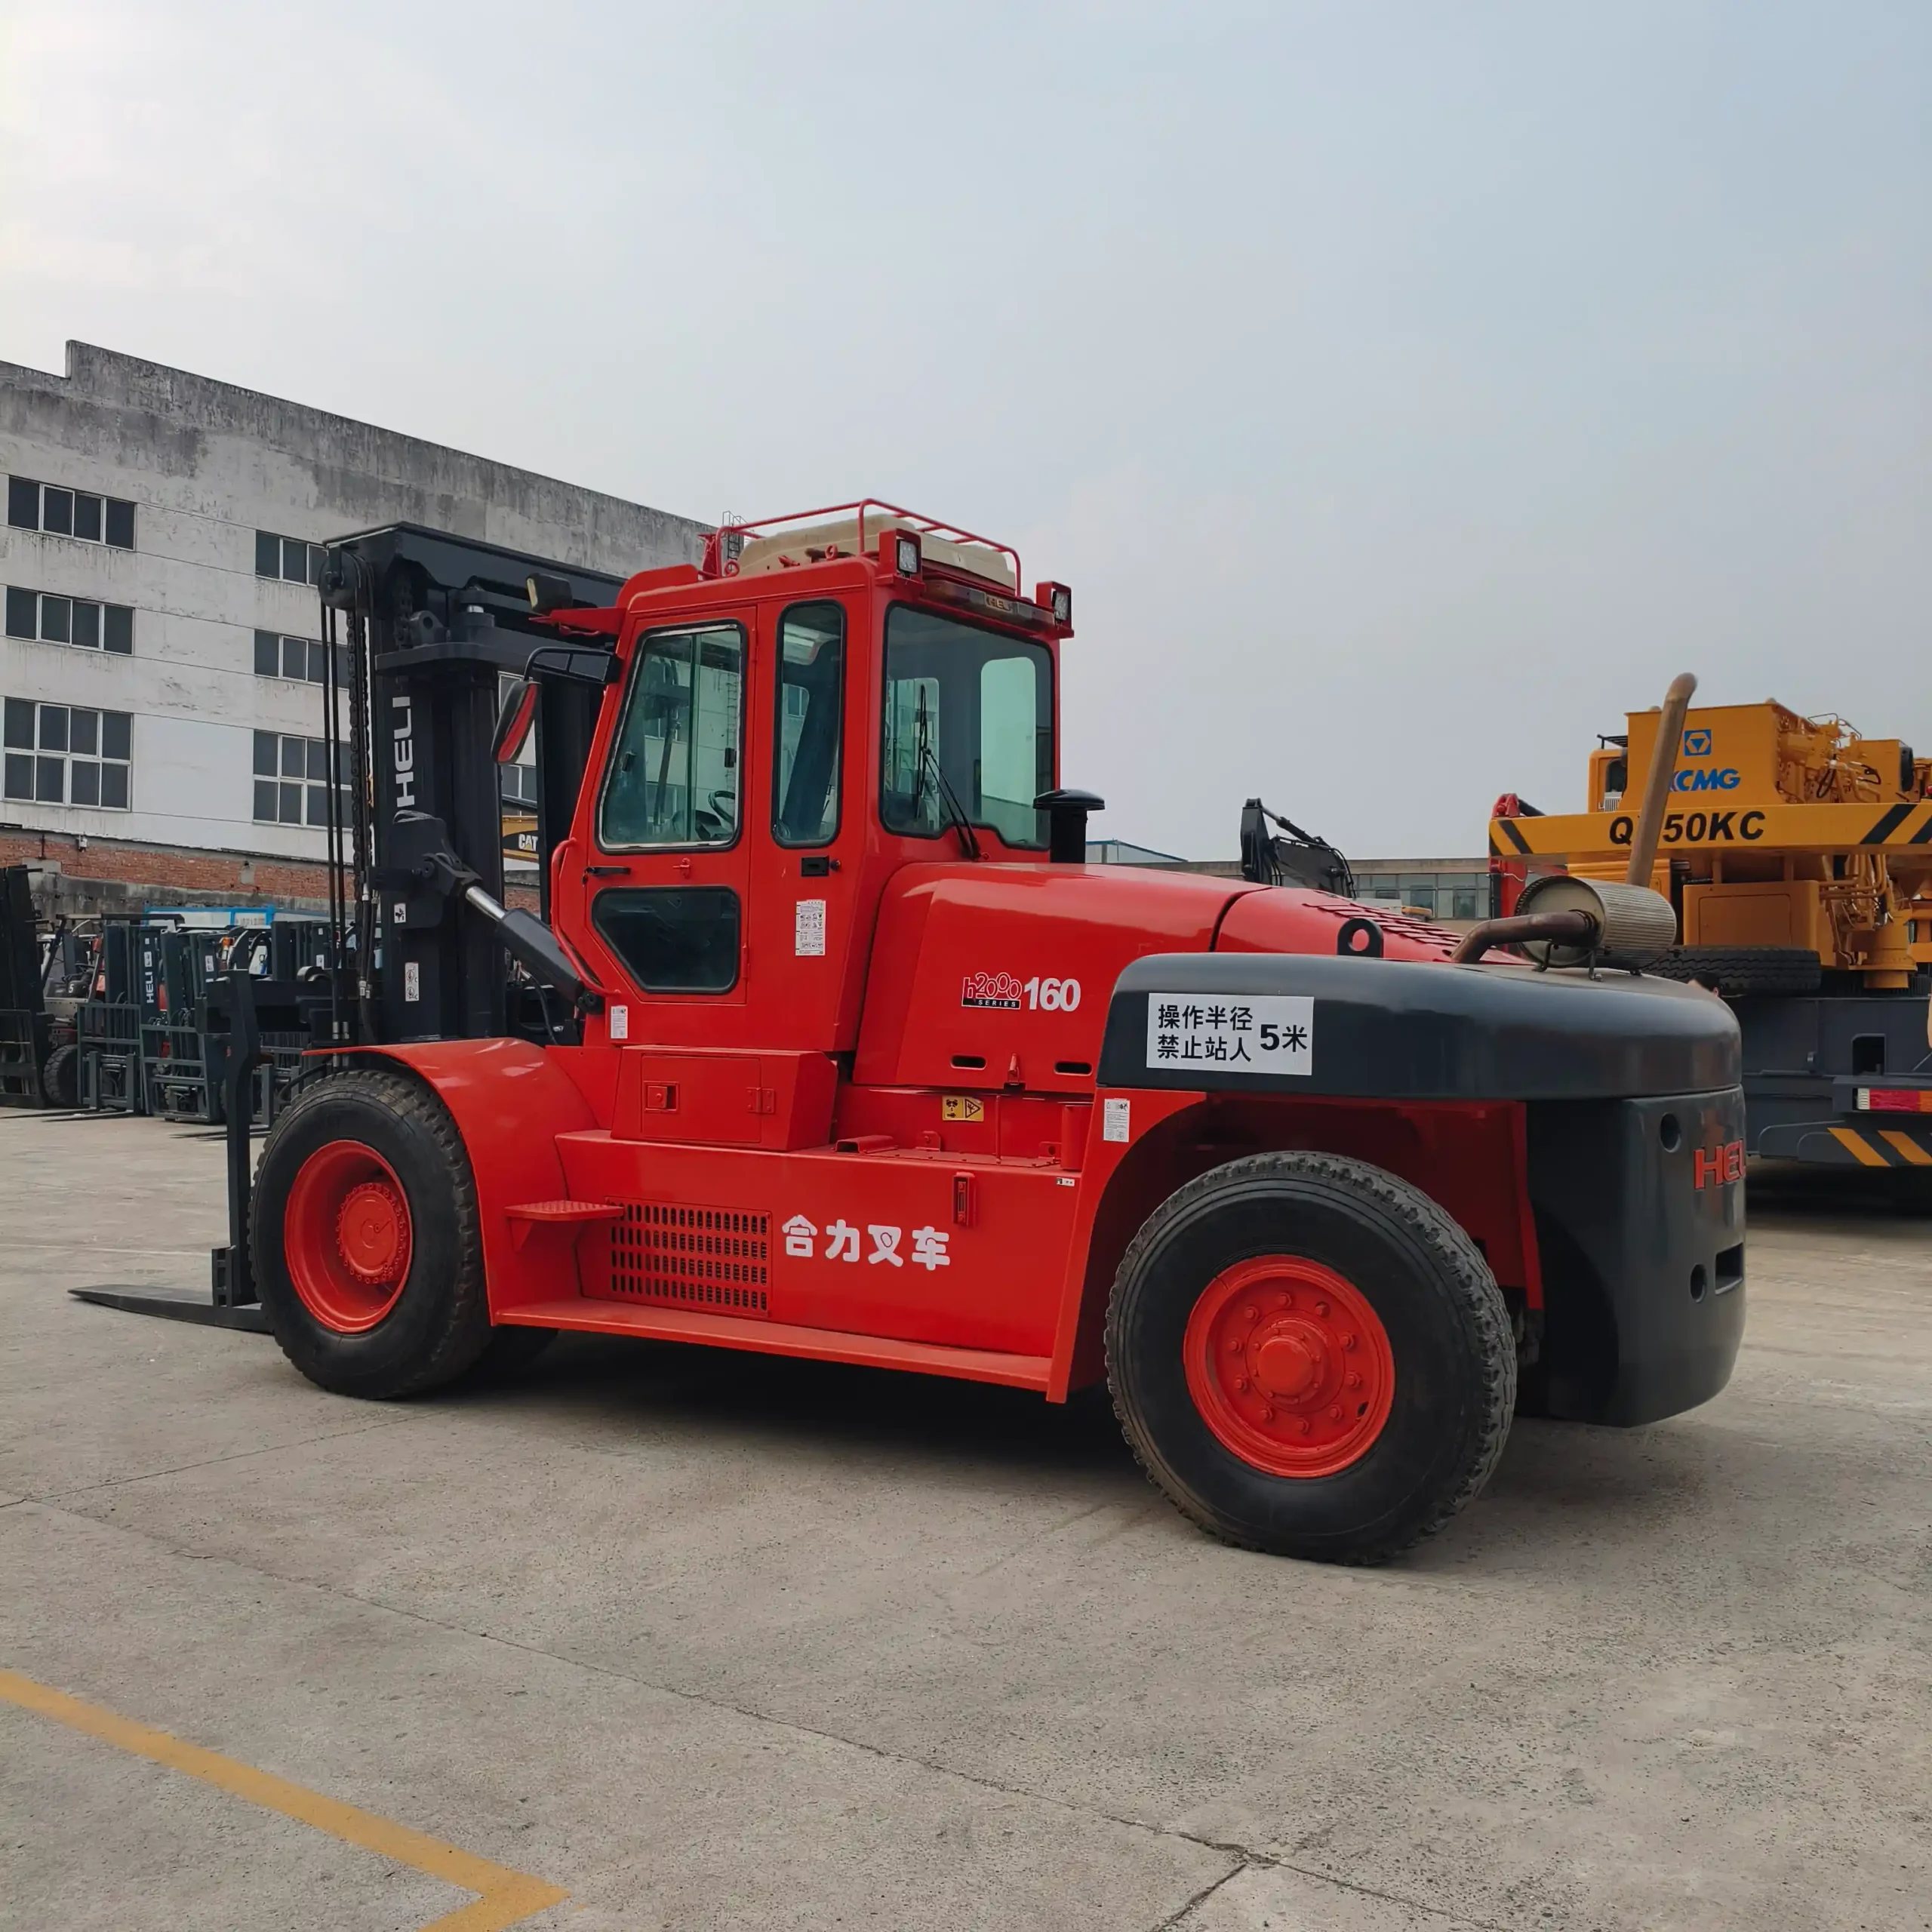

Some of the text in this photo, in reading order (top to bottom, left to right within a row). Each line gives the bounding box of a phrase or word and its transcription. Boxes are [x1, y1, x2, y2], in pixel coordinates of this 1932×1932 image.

[392, 696, 415, 808] HELI
[518, 833, 539, 852] CAT
[1609, 811, 1766, 847] Q50KC
[144, 971, 155, 1004] HELI
[1024, 977, 1081, 1012] 160
[978, 999, 1017, 1008] SERIES
[1158, 1004, 1254, 1032] 操作半径
[1157, 1033, 1252, 1063] 禁止站人
[1260, 1023, 1308, 1053] 5米
[781, 1214, 951, 1271] 合力叉车
